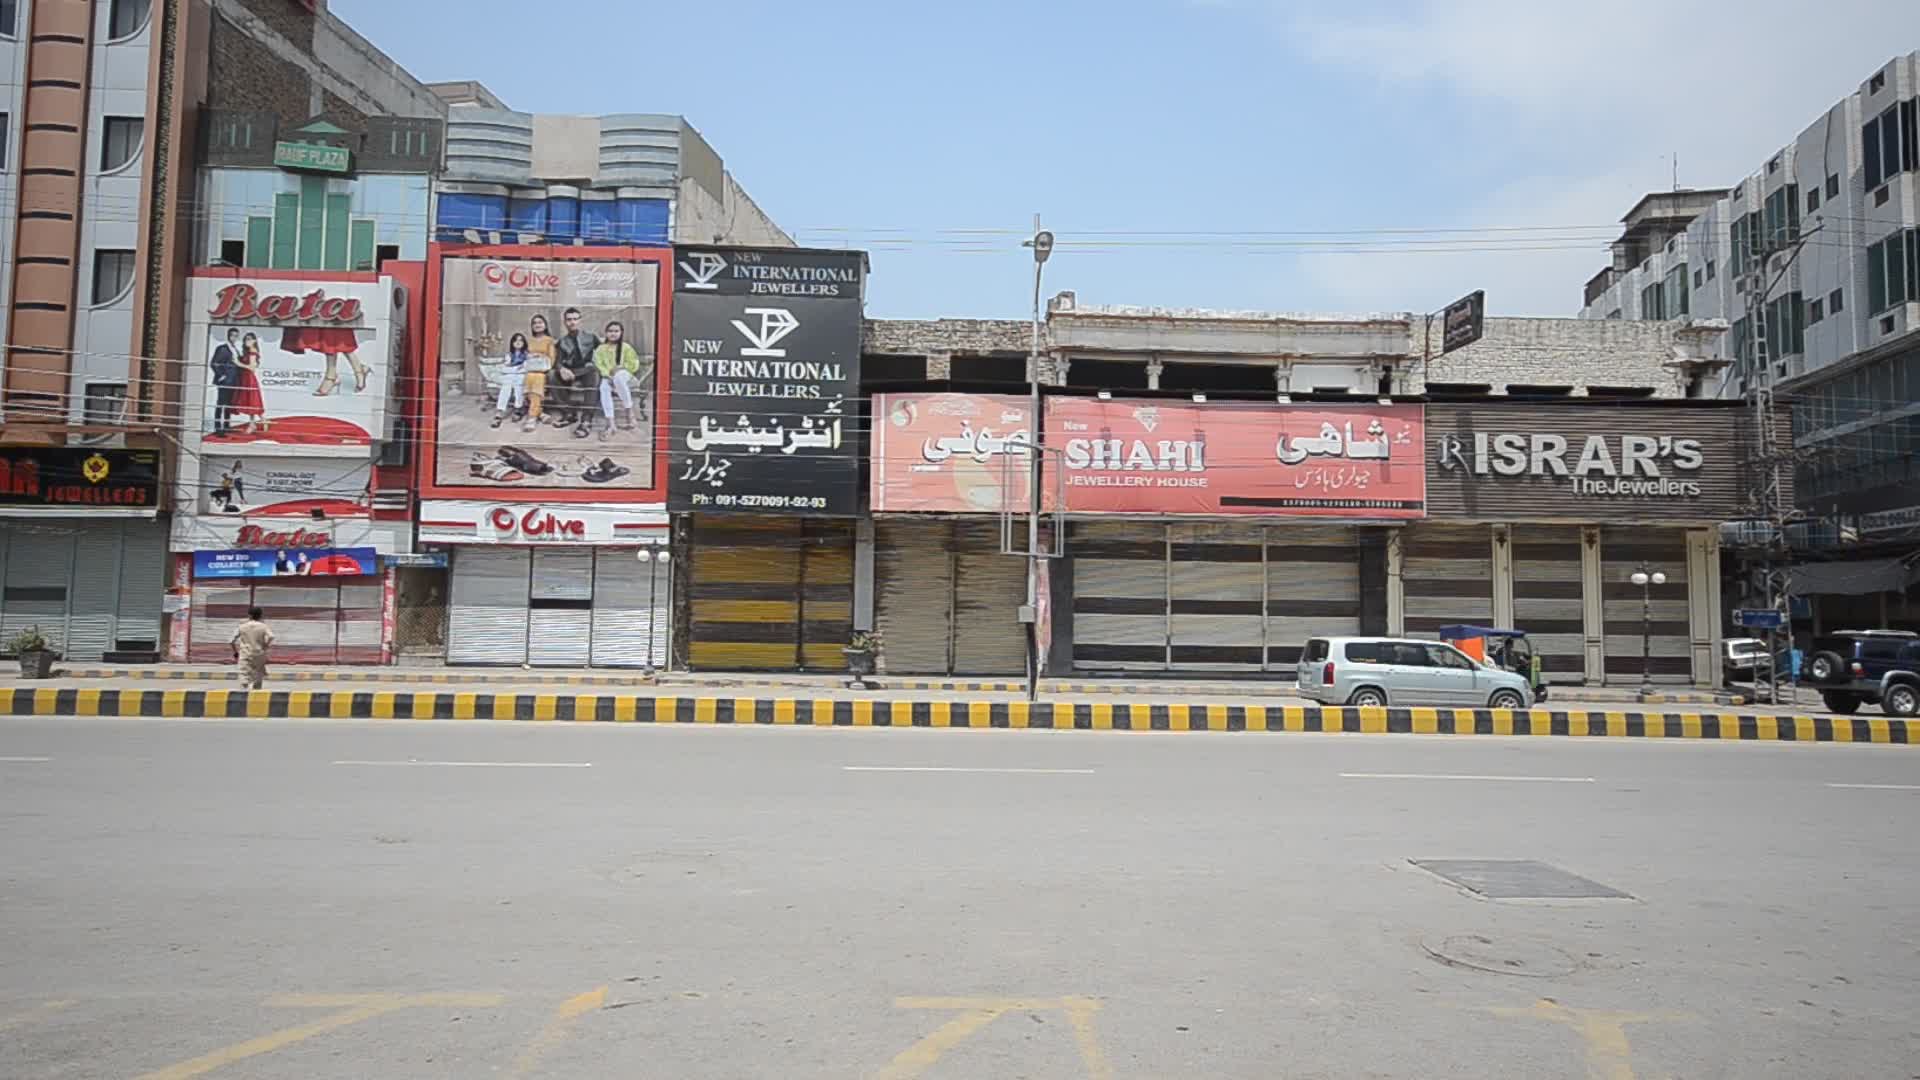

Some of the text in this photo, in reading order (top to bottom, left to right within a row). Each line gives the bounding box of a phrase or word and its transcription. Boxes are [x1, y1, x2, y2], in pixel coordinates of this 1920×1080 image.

[309, 150, 346, 166] PLAZA
[734, 252, 761, 262] NEW
[508, 264, 560, 288] Olive
[733, 264, 857, 282] INTERNATIONAL
[750, 282, 839, 296] JEWELLERS
[208, 283, 365, 322] Bata
[683, 339, 722, 354] NEW
[262, 370, 290, 378] CLASS
[681, 358, 846, 381] INTERNATIONAL
[707, 382, 820, 399] JEWELLERS
[1063, 421, 1088, 431] New
[1064, 439, 1206, 472] SHAHI
[1065, 475, 1208, 488] JEWELLERY HOUSE
[692, 494, 713, 504] Ph:
[521, 507, 585, 536] Olive
[232, 524, 332, 548] Bata
